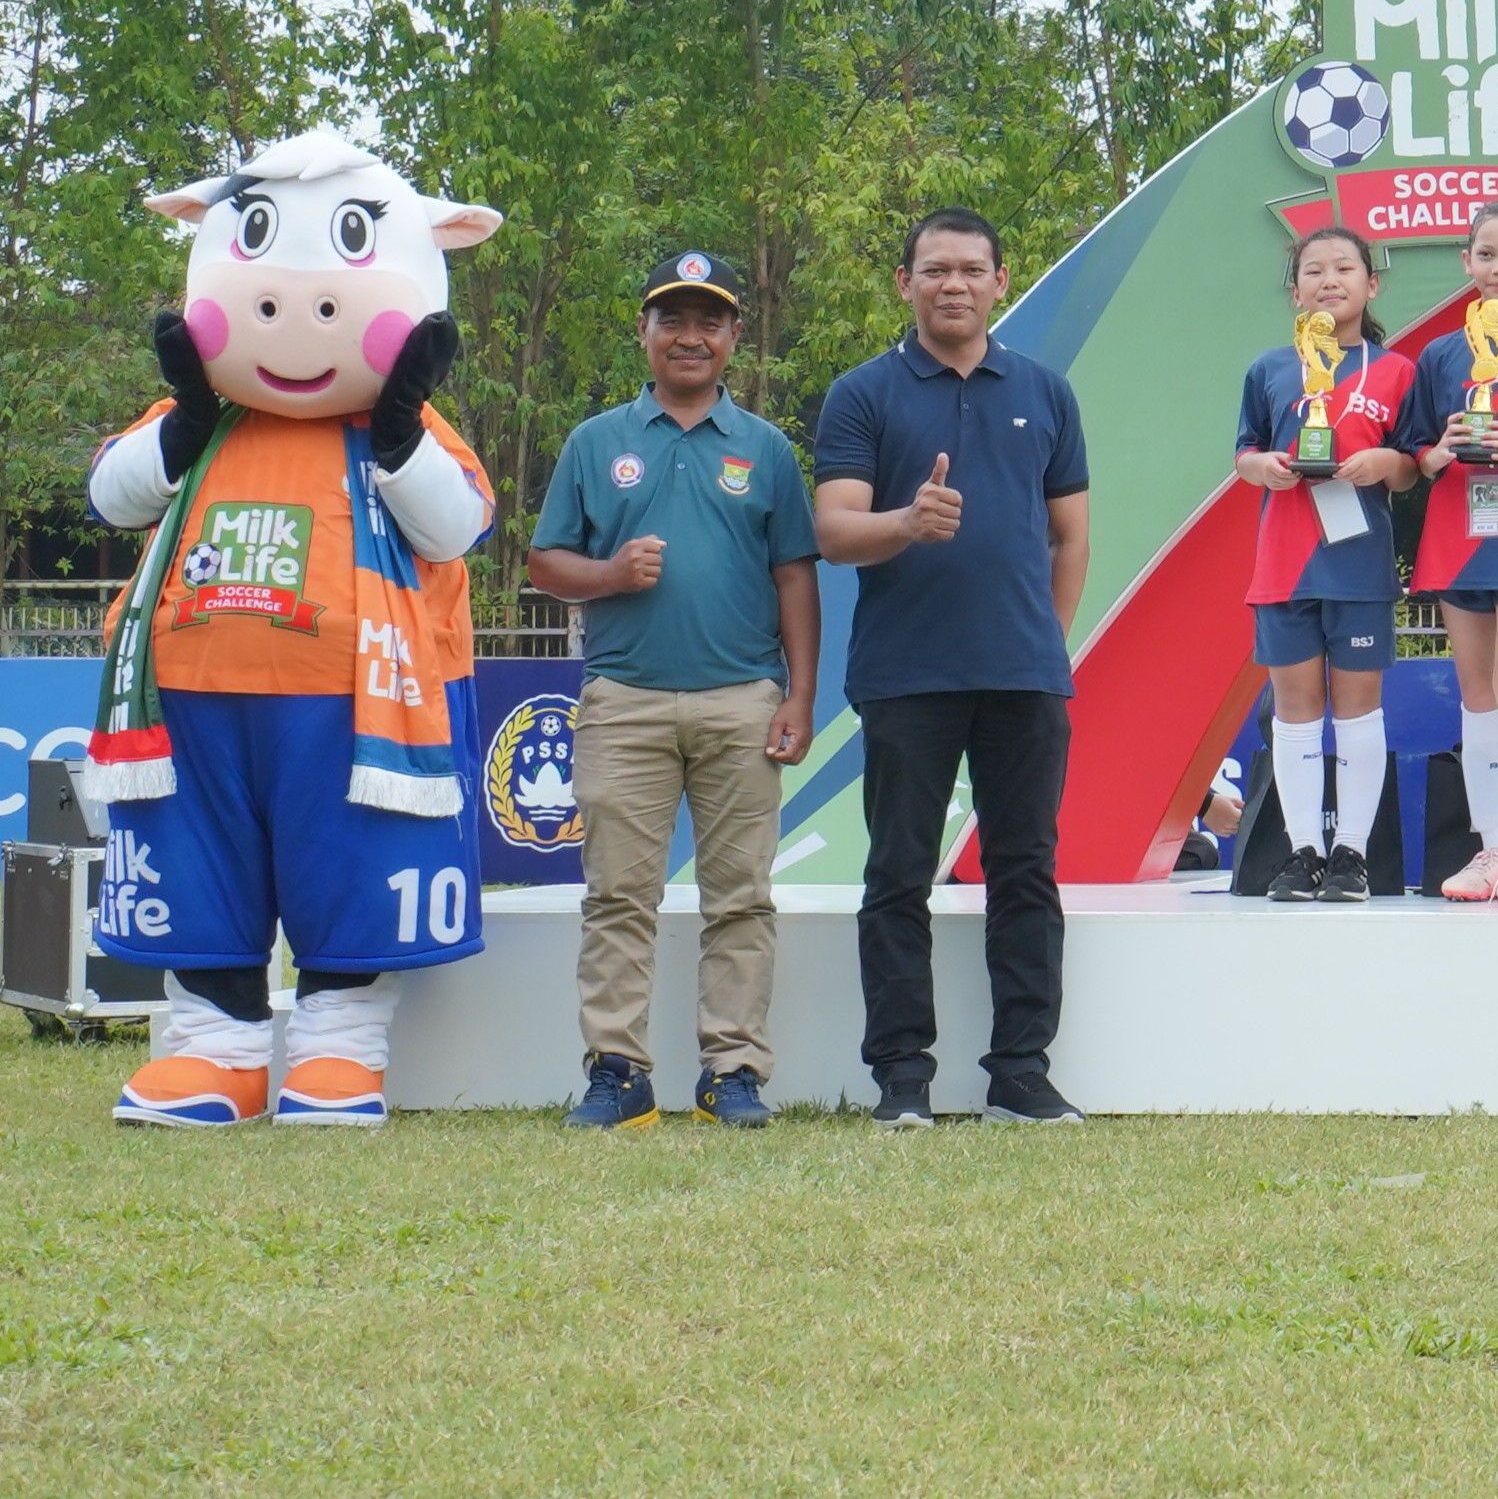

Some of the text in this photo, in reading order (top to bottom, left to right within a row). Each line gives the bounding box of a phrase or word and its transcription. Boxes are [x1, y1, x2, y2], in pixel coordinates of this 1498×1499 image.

[1348, 392, 1390, 422] BSJ
[211, 508, 300, 549] Milk
[219, 545, 300, 585] Life
[204, 598, 283, 613] CHALLENGE
[217, 586, 272, 599] SOCCER
[1351, 635, 1374, 648] BSJ
[387, 867, 467, 944] 10
